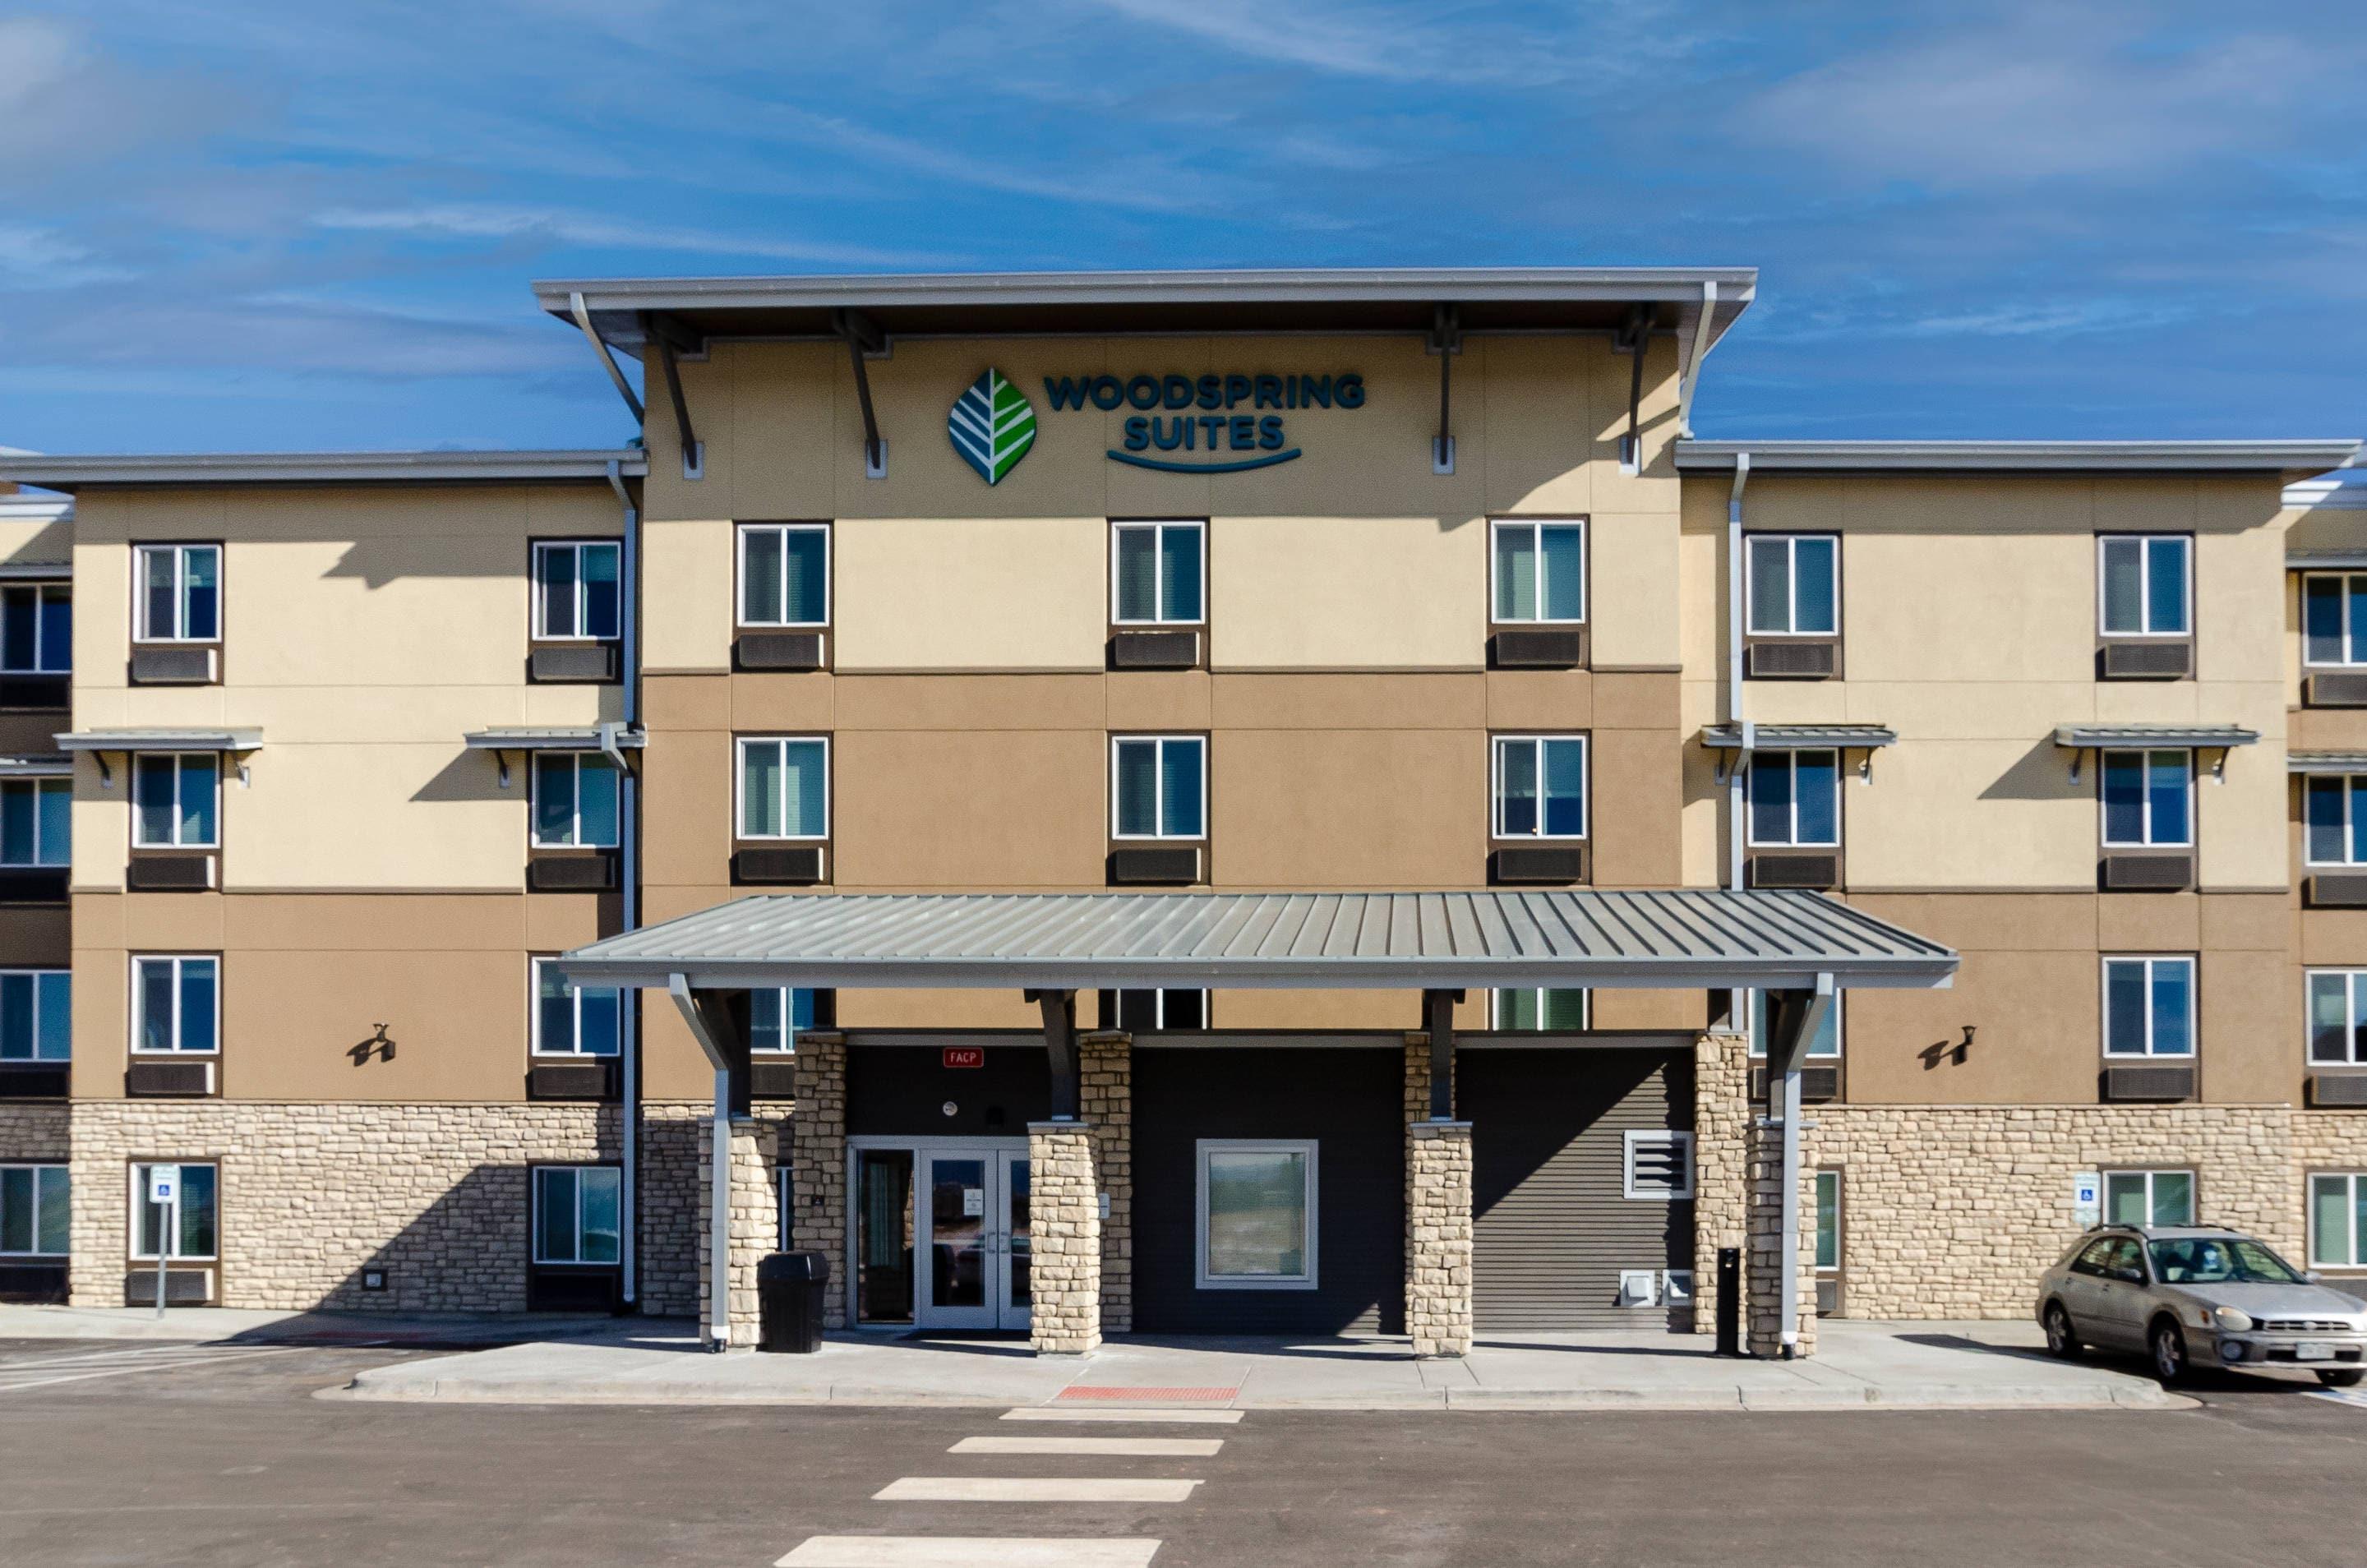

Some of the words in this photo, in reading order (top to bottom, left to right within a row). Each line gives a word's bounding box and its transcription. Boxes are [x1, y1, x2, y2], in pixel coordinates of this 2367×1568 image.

[1043, 375, 1365, 411] WOODSPRING
[1124, 415, 1285, 451] SUITES
[950, 1051, 977, 1063] FACP
